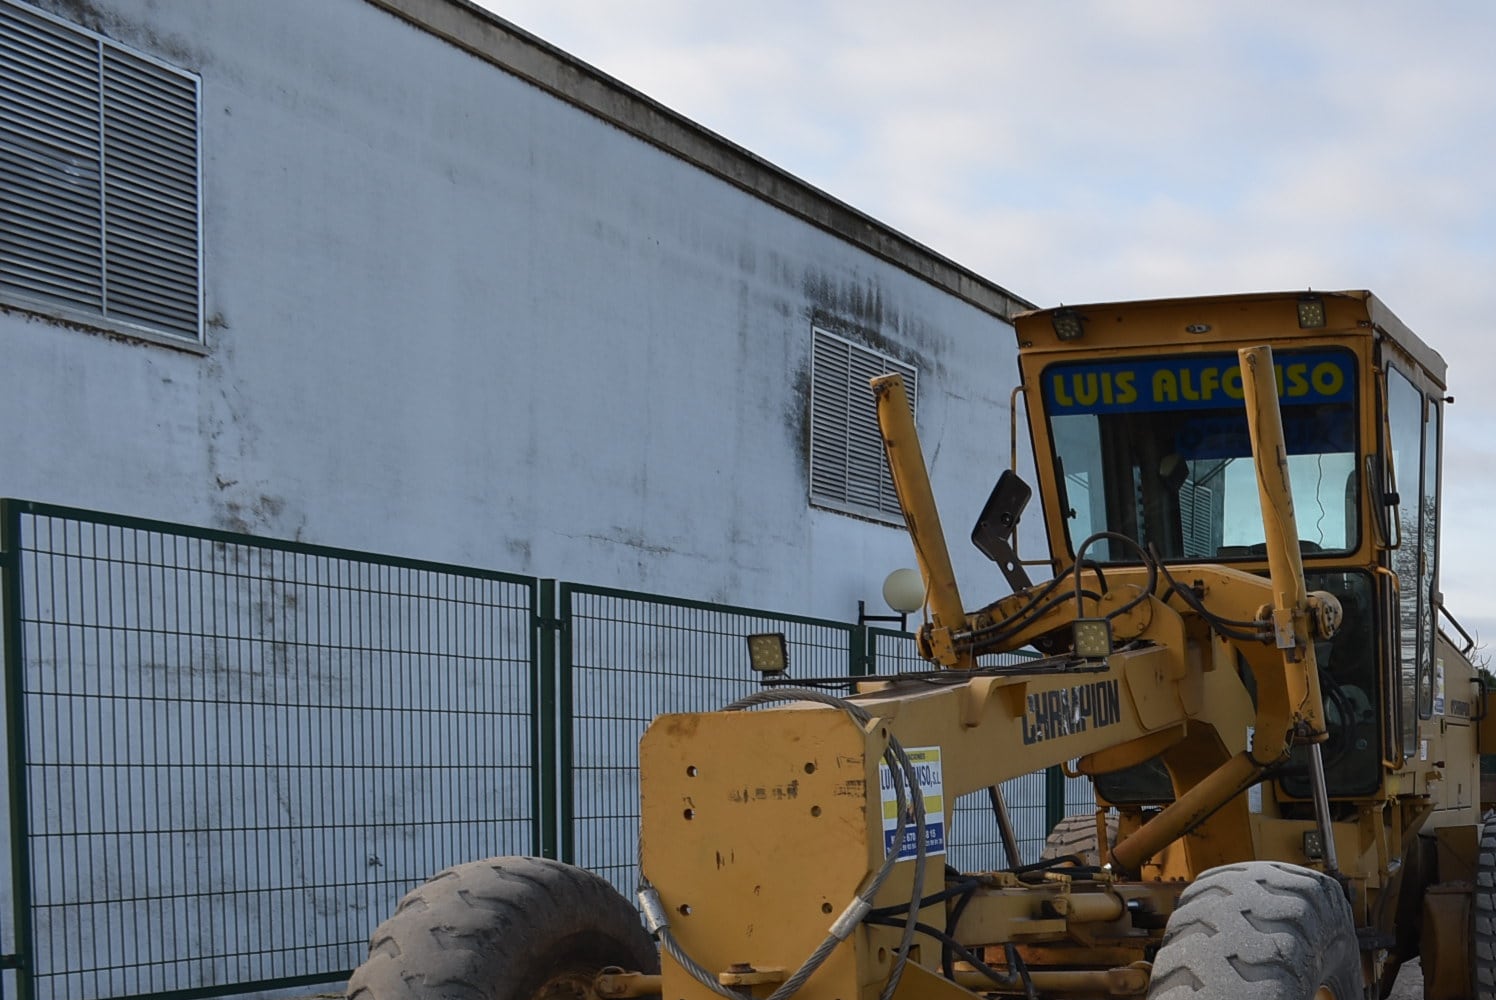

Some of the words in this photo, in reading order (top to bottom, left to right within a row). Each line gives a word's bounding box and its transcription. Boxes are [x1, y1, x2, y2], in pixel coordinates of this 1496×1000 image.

[1053, 370, 1138, 406] LUIS
[1152, 362, 1344, 402] ALFOSO
[1022, 679, 1120, 745] CHAMPION
